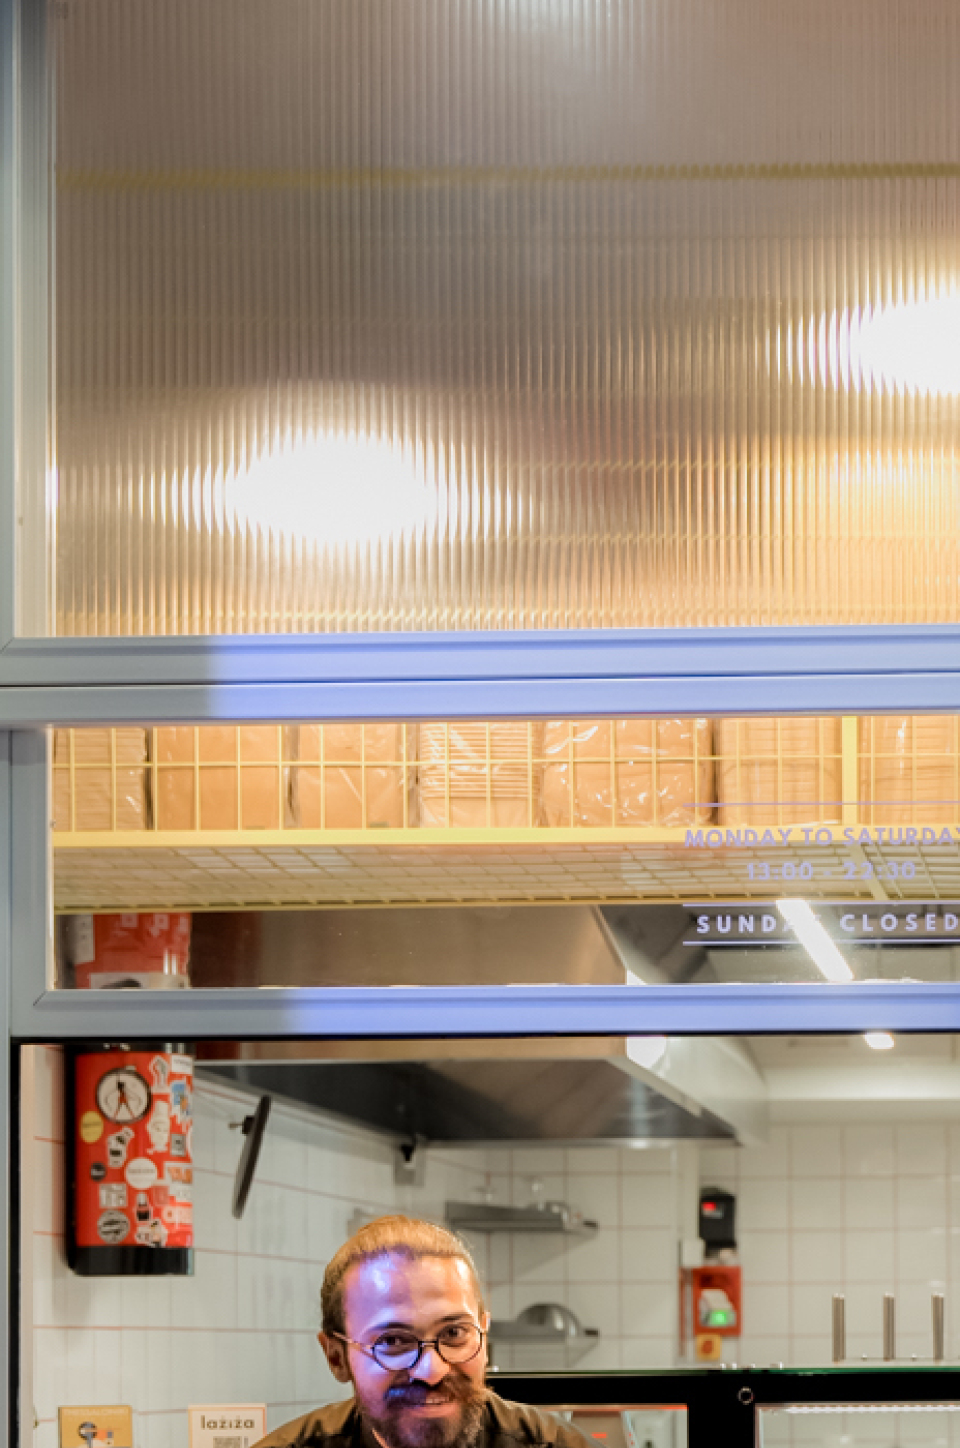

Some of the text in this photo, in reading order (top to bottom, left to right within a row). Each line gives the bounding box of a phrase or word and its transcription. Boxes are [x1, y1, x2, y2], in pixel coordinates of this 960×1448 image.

[684, 829, 793, 847] MONDAY
[801, 828, 833, 846] TO
[746, 862, 814, 881] 13:00
[843, 861, 916, 880] 22:30
[839, 913, 960, 932] CLOSED
